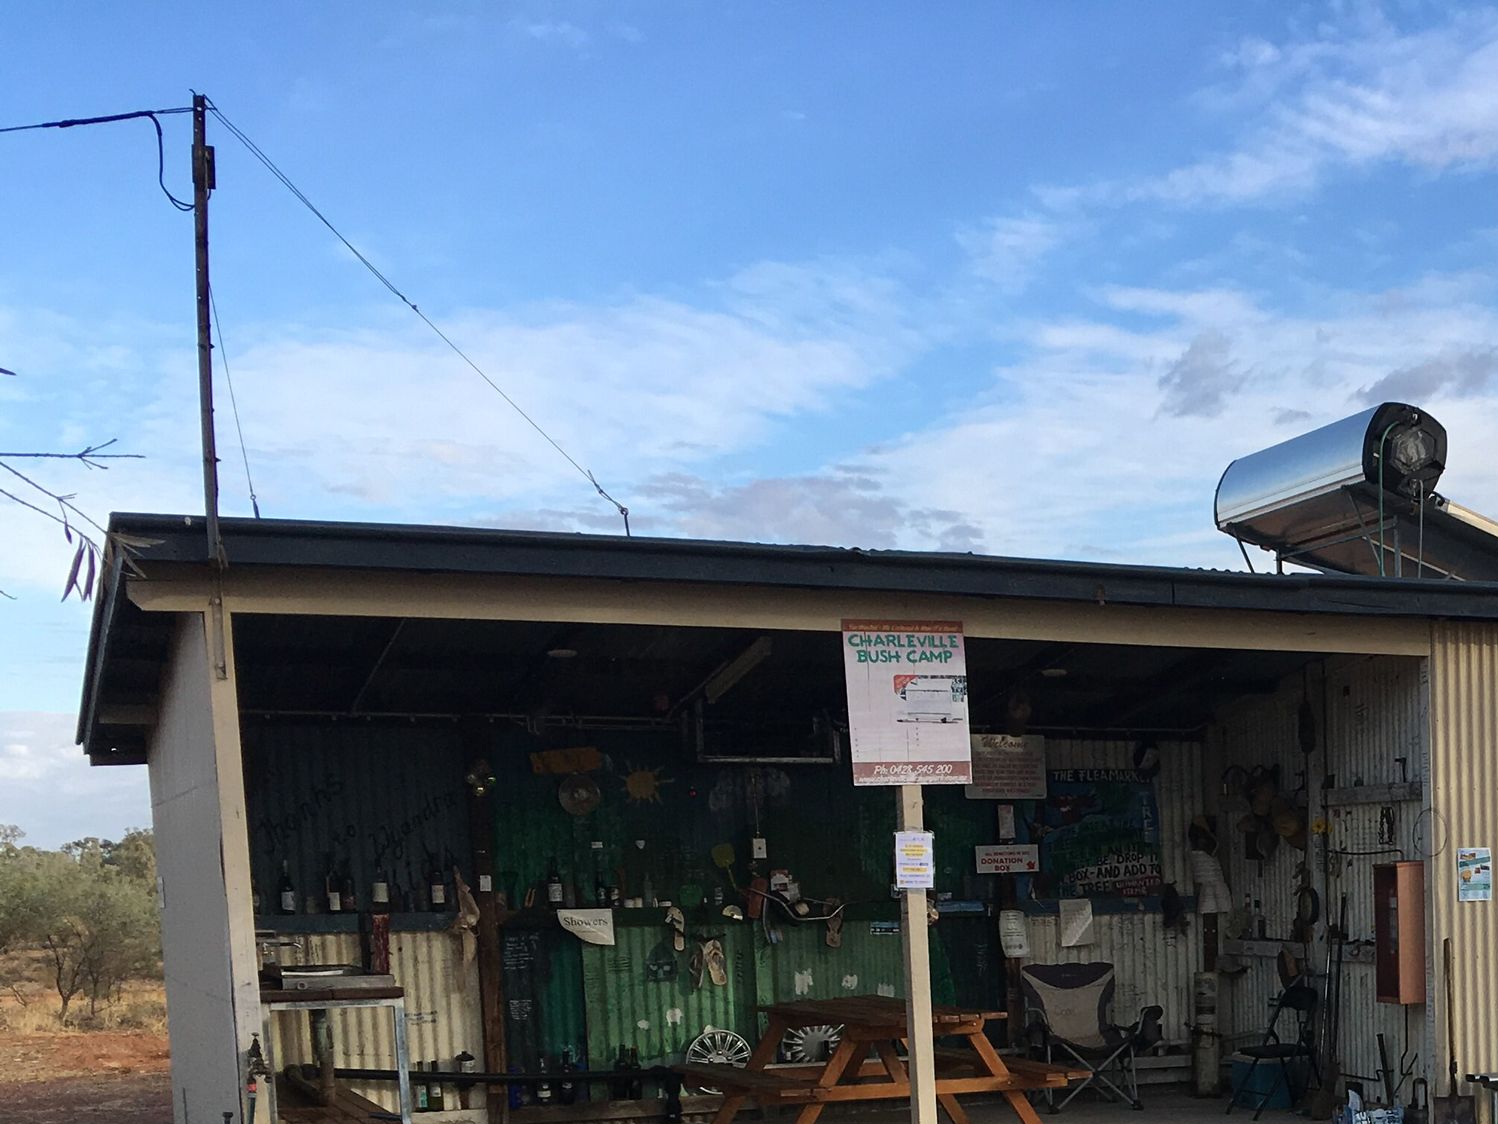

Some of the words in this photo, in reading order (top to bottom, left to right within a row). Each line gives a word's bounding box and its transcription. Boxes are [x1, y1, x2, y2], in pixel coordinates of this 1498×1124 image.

[848, 633, 959, 648] CHARLEVILLE
[857, 649, 901, 664] BUSH
[906, 649, 953, 663] CAMP
[936, 763, 953, 774] 200
[1052, 770, 1074, 783] THE
[981, 857, 1023, 865] DONATION
[1117, 853, 1143, 864] DROP
[1124, 863, 1147, 876] ADD
[1079, 880, 1109, 893] TREE
[563, 916, 608, 927] Showers
